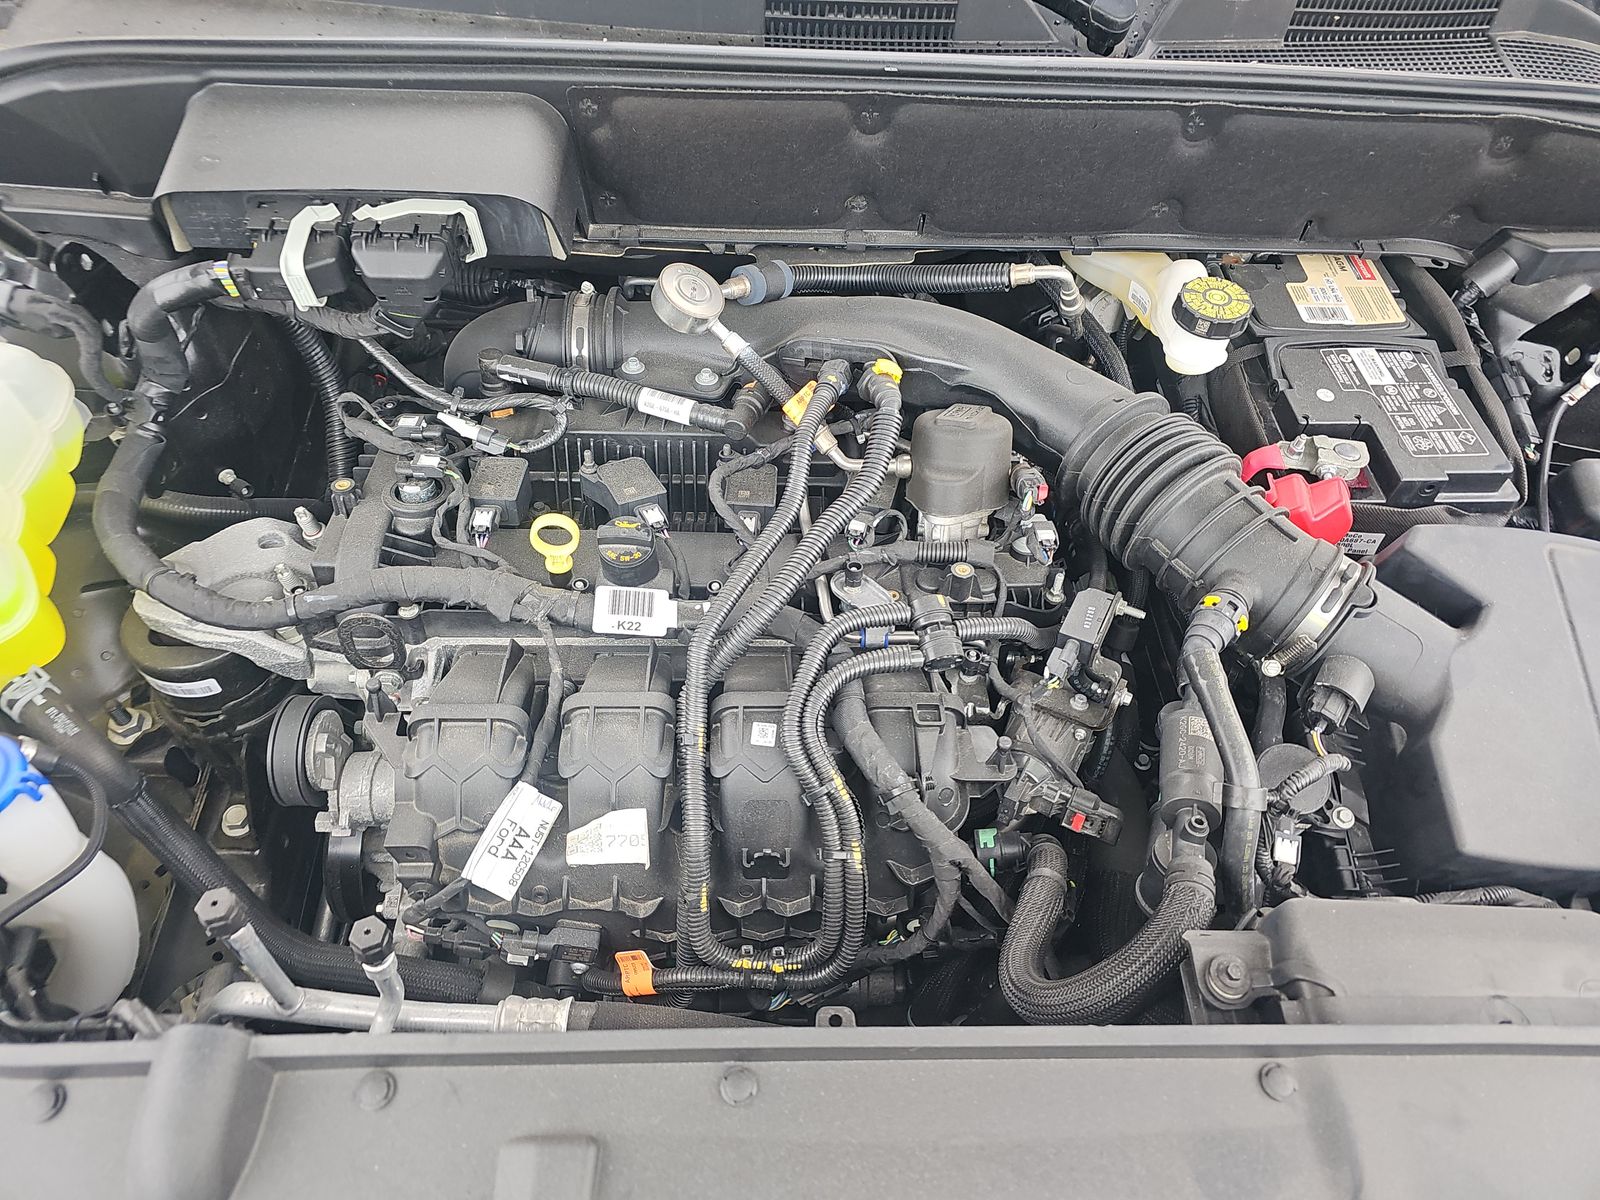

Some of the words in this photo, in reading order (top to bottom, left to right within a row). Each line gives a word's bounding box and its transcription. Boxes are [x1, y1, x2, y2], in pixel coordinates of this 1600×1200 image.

[1333, 256, 1348, 272] AGM
[617, 621, 641, 631] K22
[487, 818, 518, 858] Ford
[501, 826, 531, 861] AAA
